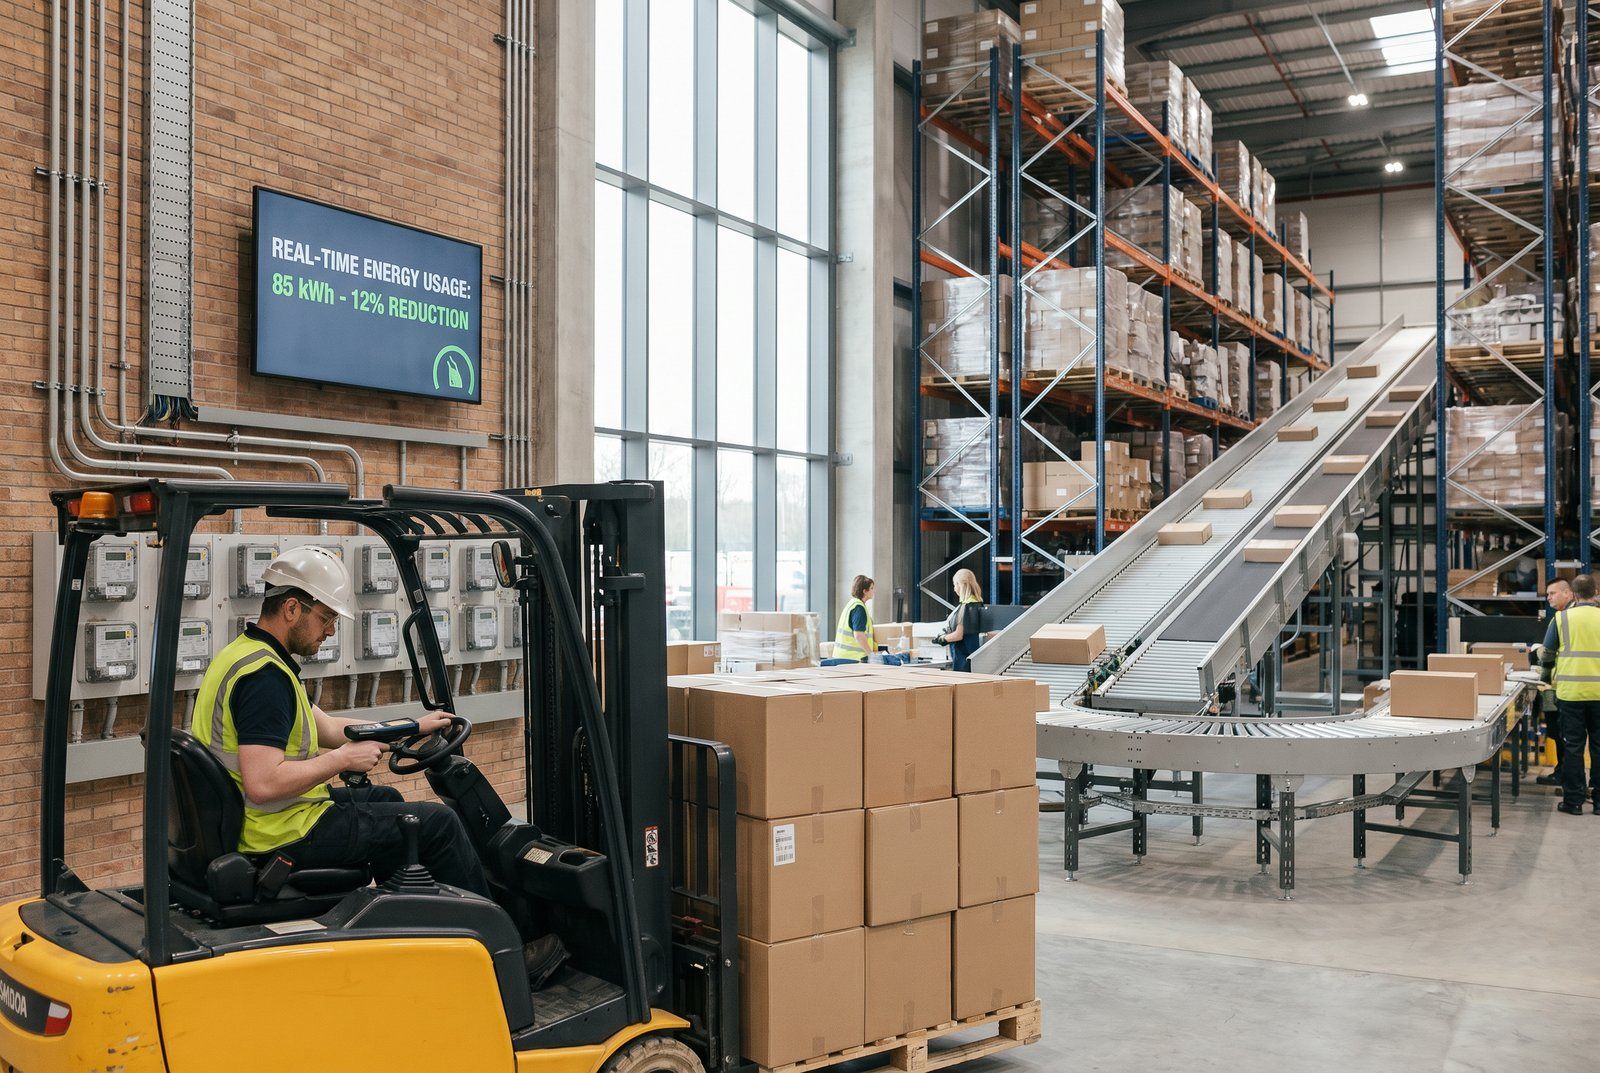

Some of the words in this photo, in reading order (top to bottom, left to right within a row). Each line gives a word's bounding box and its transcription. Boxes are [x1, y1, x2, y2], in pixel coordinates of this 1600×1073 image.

[272, 237, 359, 275] REAL-TIME
[363, 258, 420, 288] ENERGY
[423, 272, 471, 299] USAGE:
[272, 272, 293, 297] 85
[298, 277, 335, 305] kWh
[351, 289, 385, 315] 12%
[388, 296, 469, 330] REDUCTION
